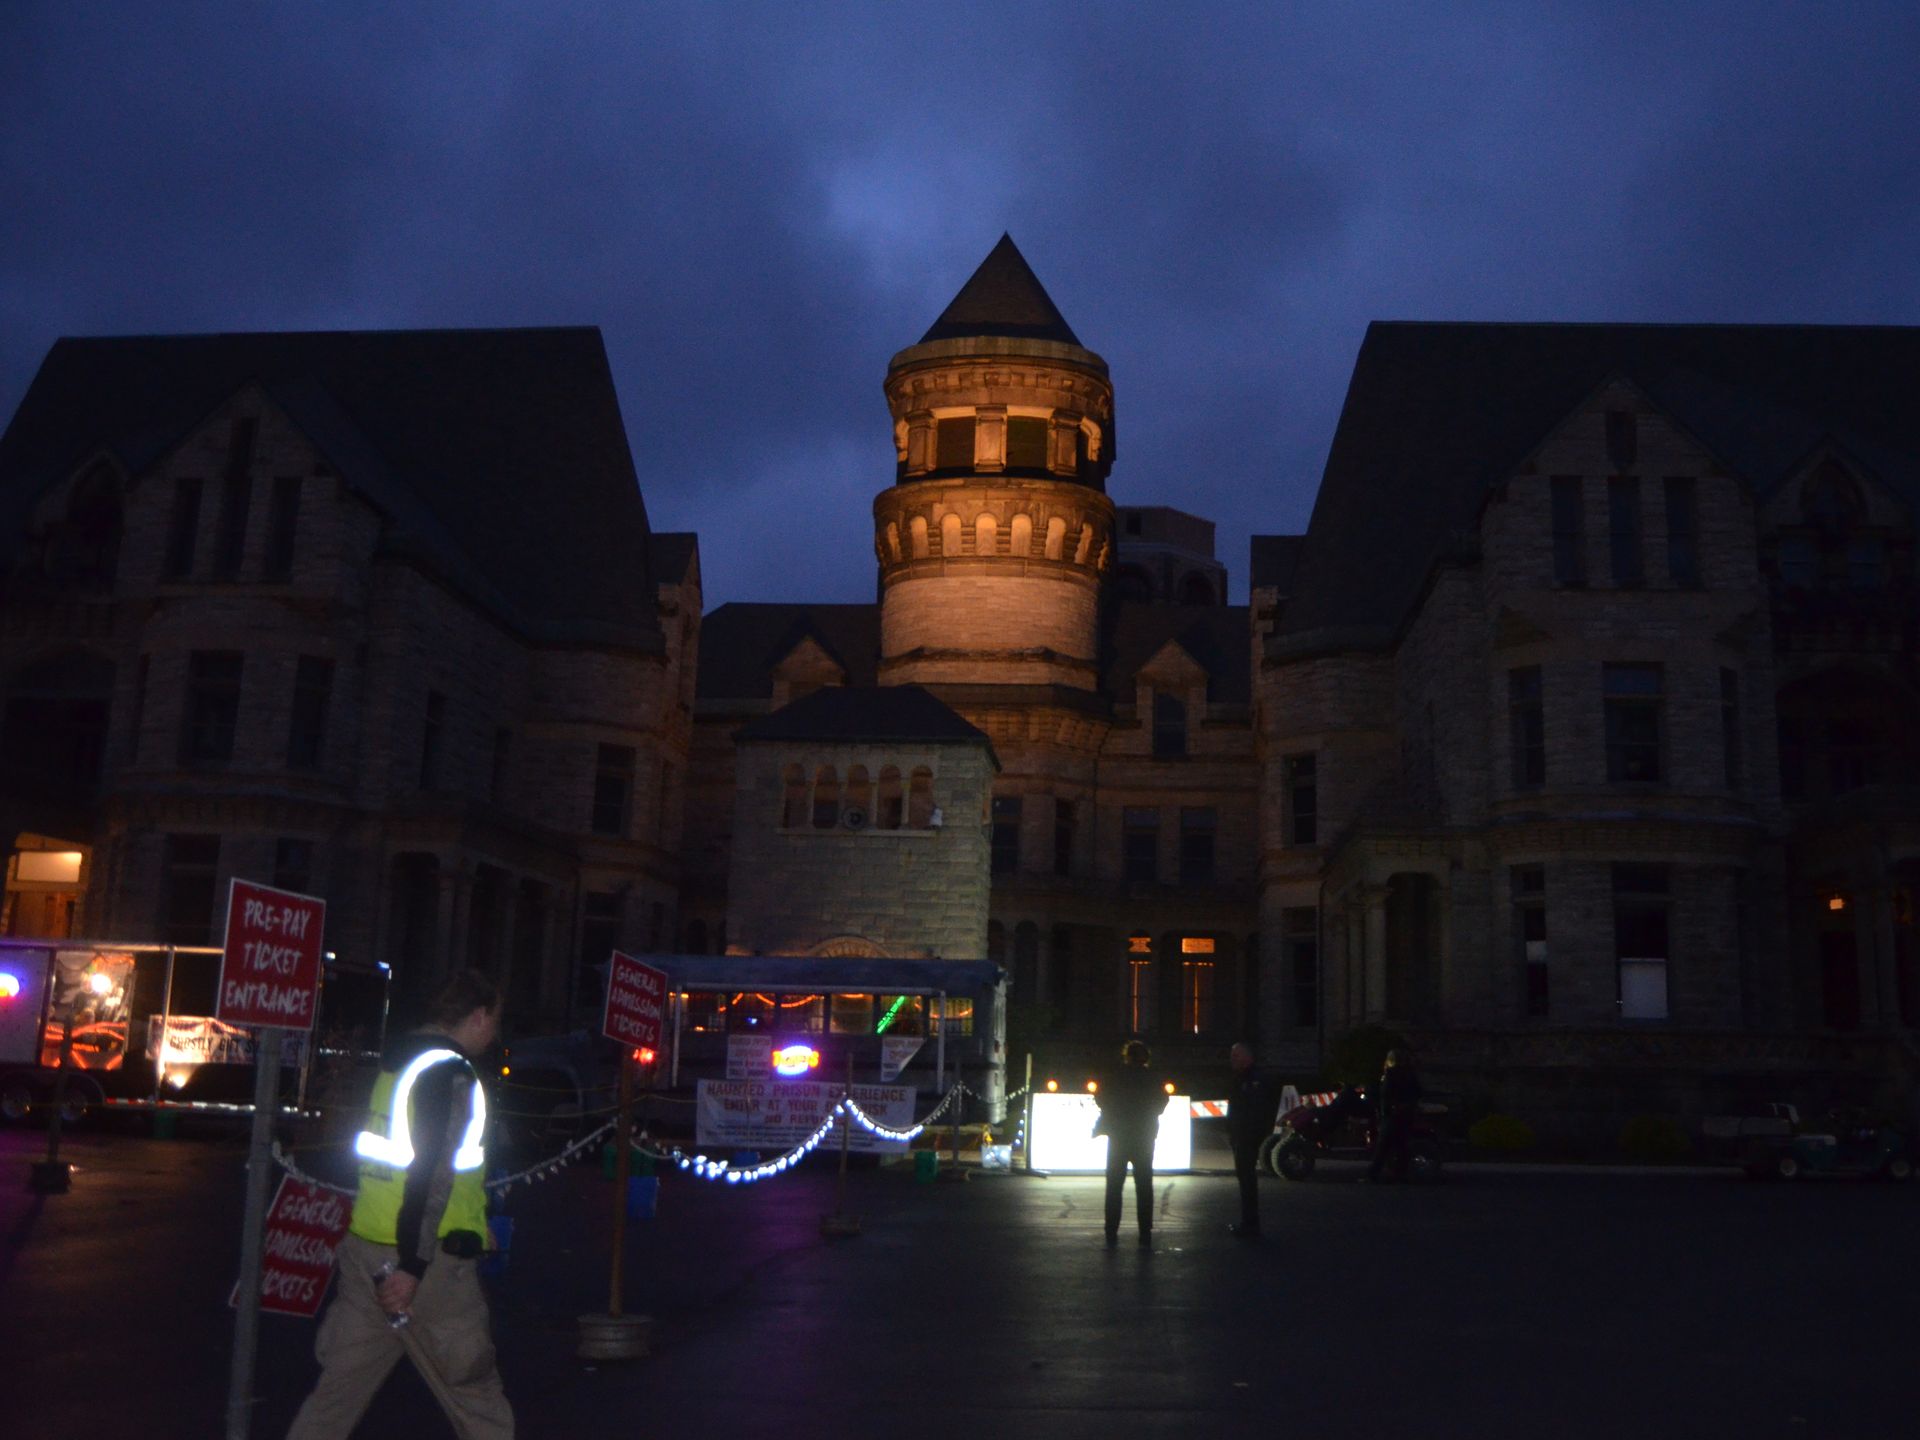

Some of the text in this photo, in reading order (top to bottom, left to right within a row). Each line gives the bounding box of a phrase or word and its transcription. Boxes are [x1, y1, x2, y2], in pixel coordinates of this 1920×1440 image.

[244, 898, 311, 941] PRE-PAY
[243, 941, 303, 975] TICKET
[225, 980, 311, 1016] ENTRANCE
[767, 1100, 780, 1112] AT
[774, 1084, 820, 1098] PRISON
[828, 1085, 906, 1101] EXERIENCE
[278, 1195, 345, 1231] GENERAL
[261, 1267, 320, 1303] ICKETS
